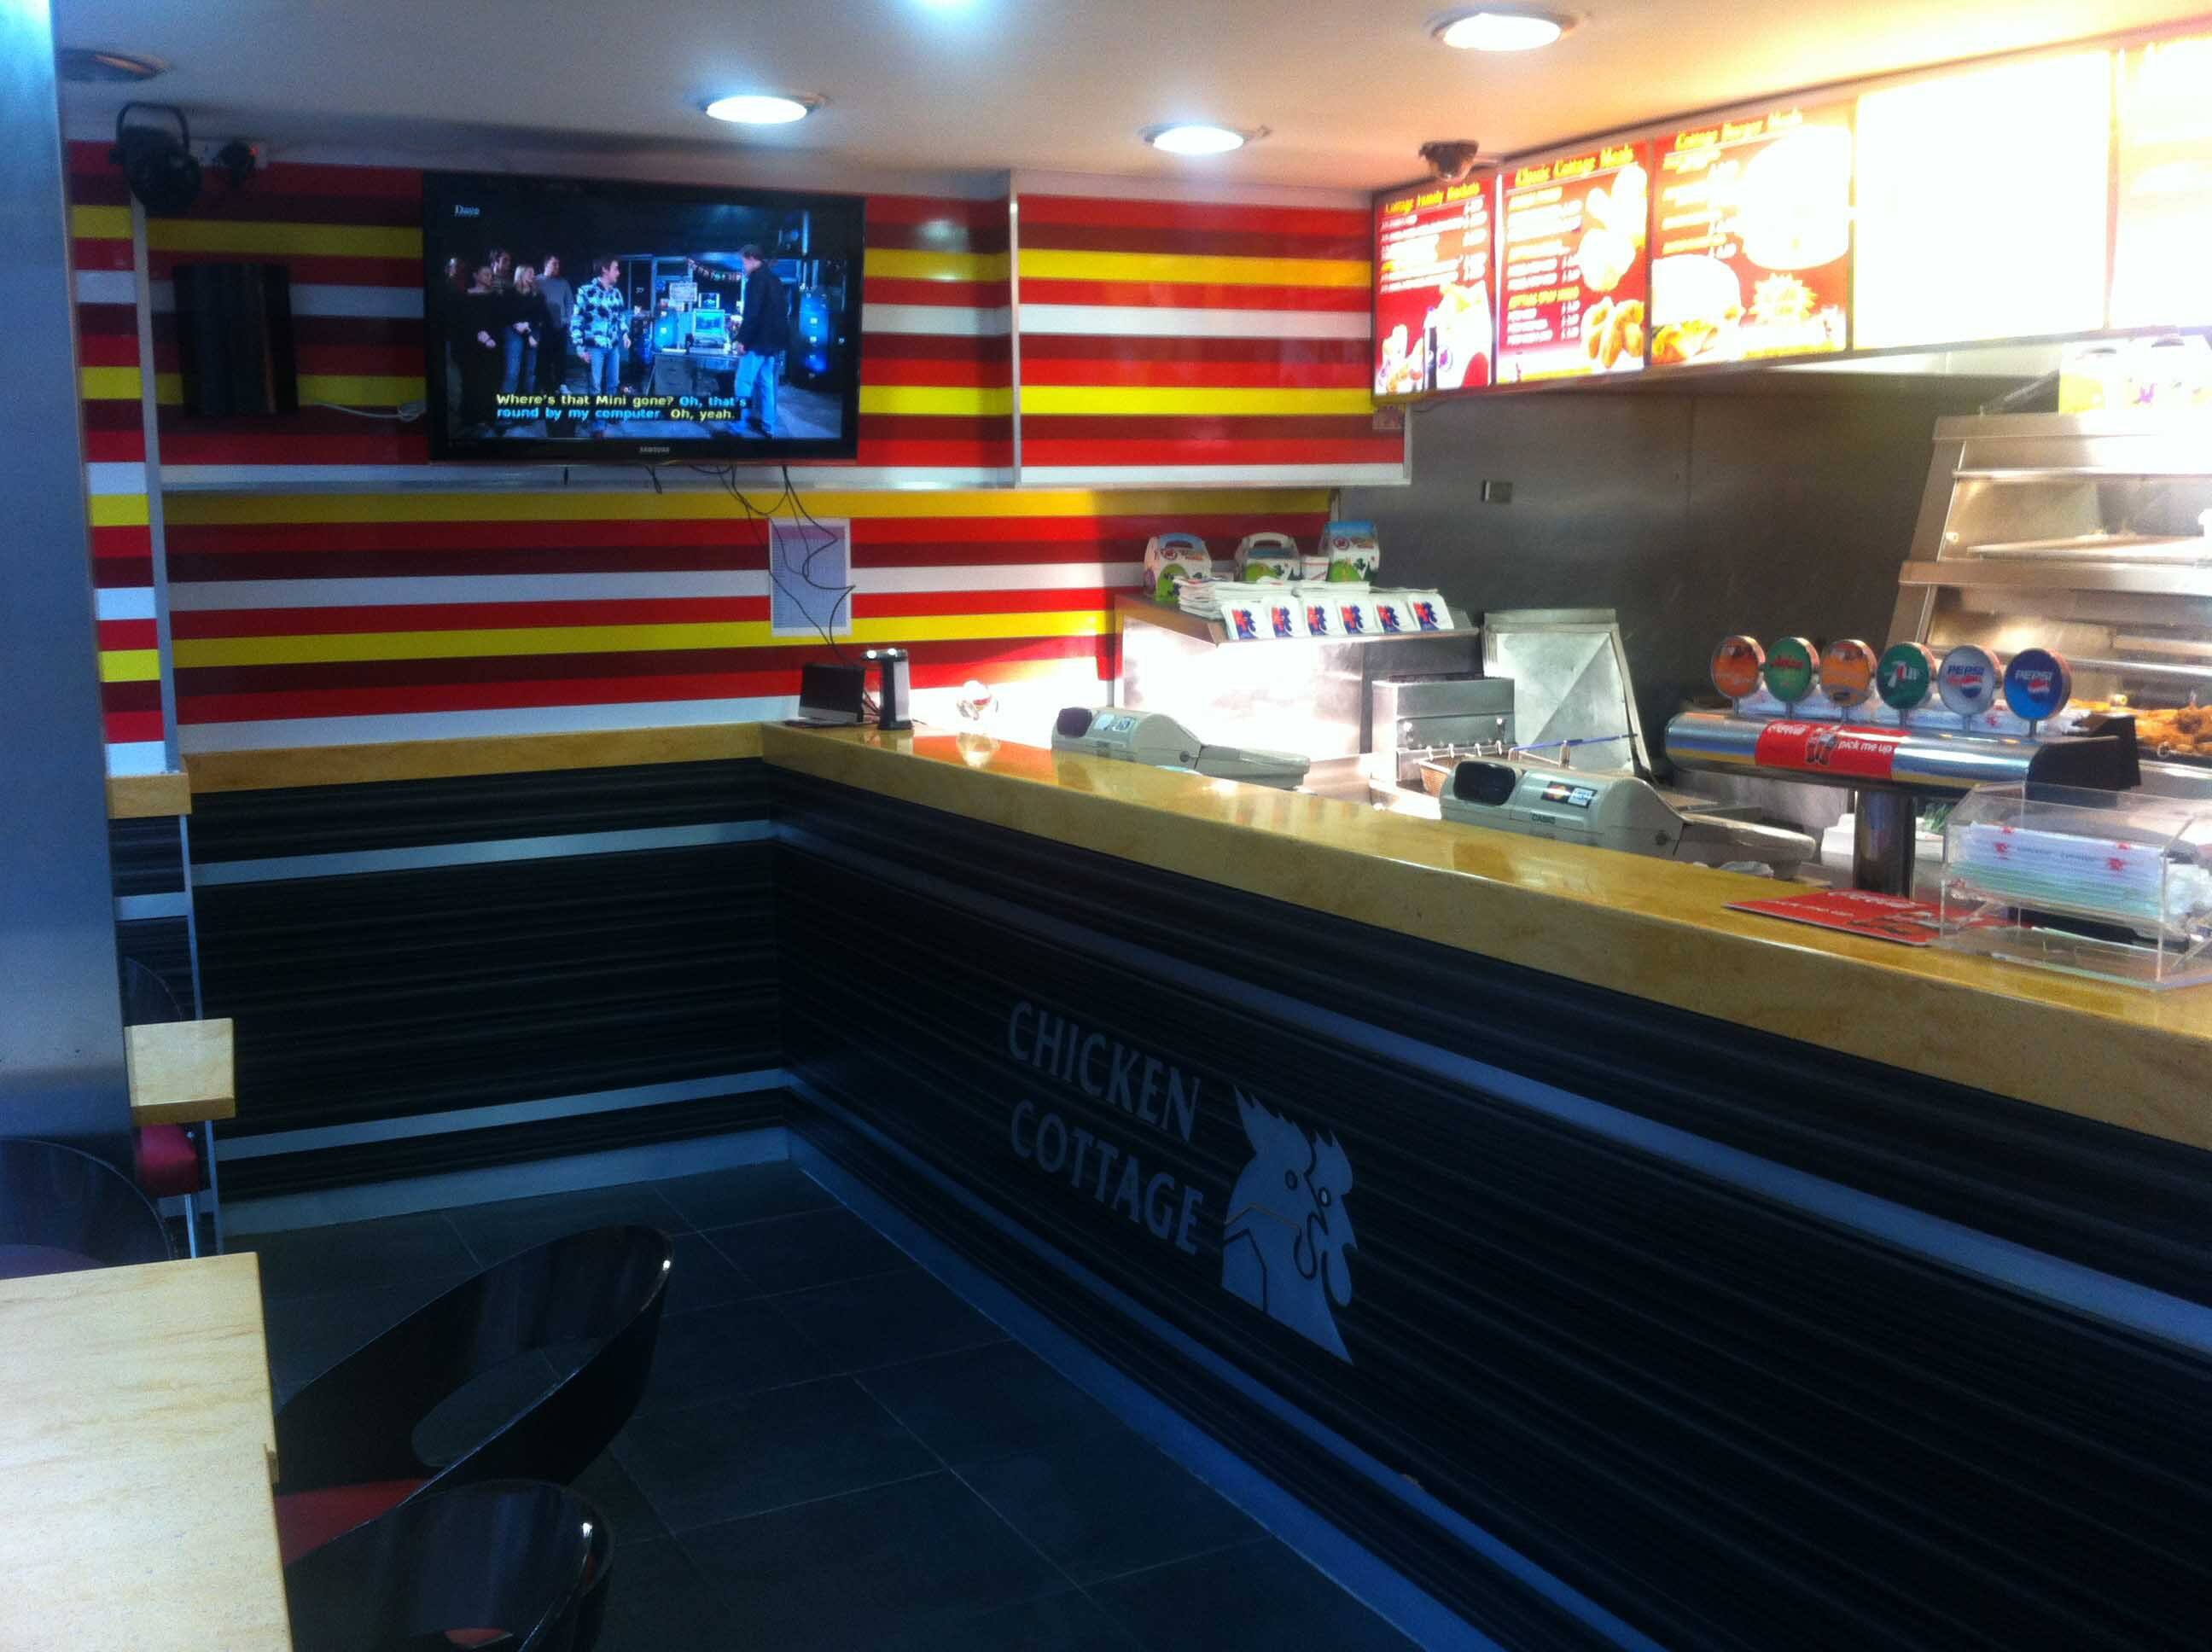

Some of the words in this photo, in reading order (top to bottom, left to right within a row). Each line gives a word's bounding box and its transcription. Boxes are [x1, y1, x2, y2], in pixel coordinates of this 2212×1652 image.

[496, 393, 556, 405] Where's
[561, 394, 590, 405] that
[596, 394, 626, 405] Mini
[633, 395, 674, 407] gone?
[679, 396, 702, 408] Oh,
[708, 396, 747, 407] that's
[497, 407, 538, 418] round
[545, 408, 561, 421] by
[568, 409, 589, 421] my
[670, 409, 694, 421] Oh,
[700, 410, 735, 422] yeah.
[1948, 664, 1984, 677] PEPSI
[2015, 668, 2053, 682] PEPSI
[1838, 740, 1860, 751] pick
[1860, 743, 1877, 752] me
[1878, 744, 1893, 755] up
[1008, 1001, 1201, 1143] CHICKEN
[1011, 1098, 1203, 1256] COTTAGE
